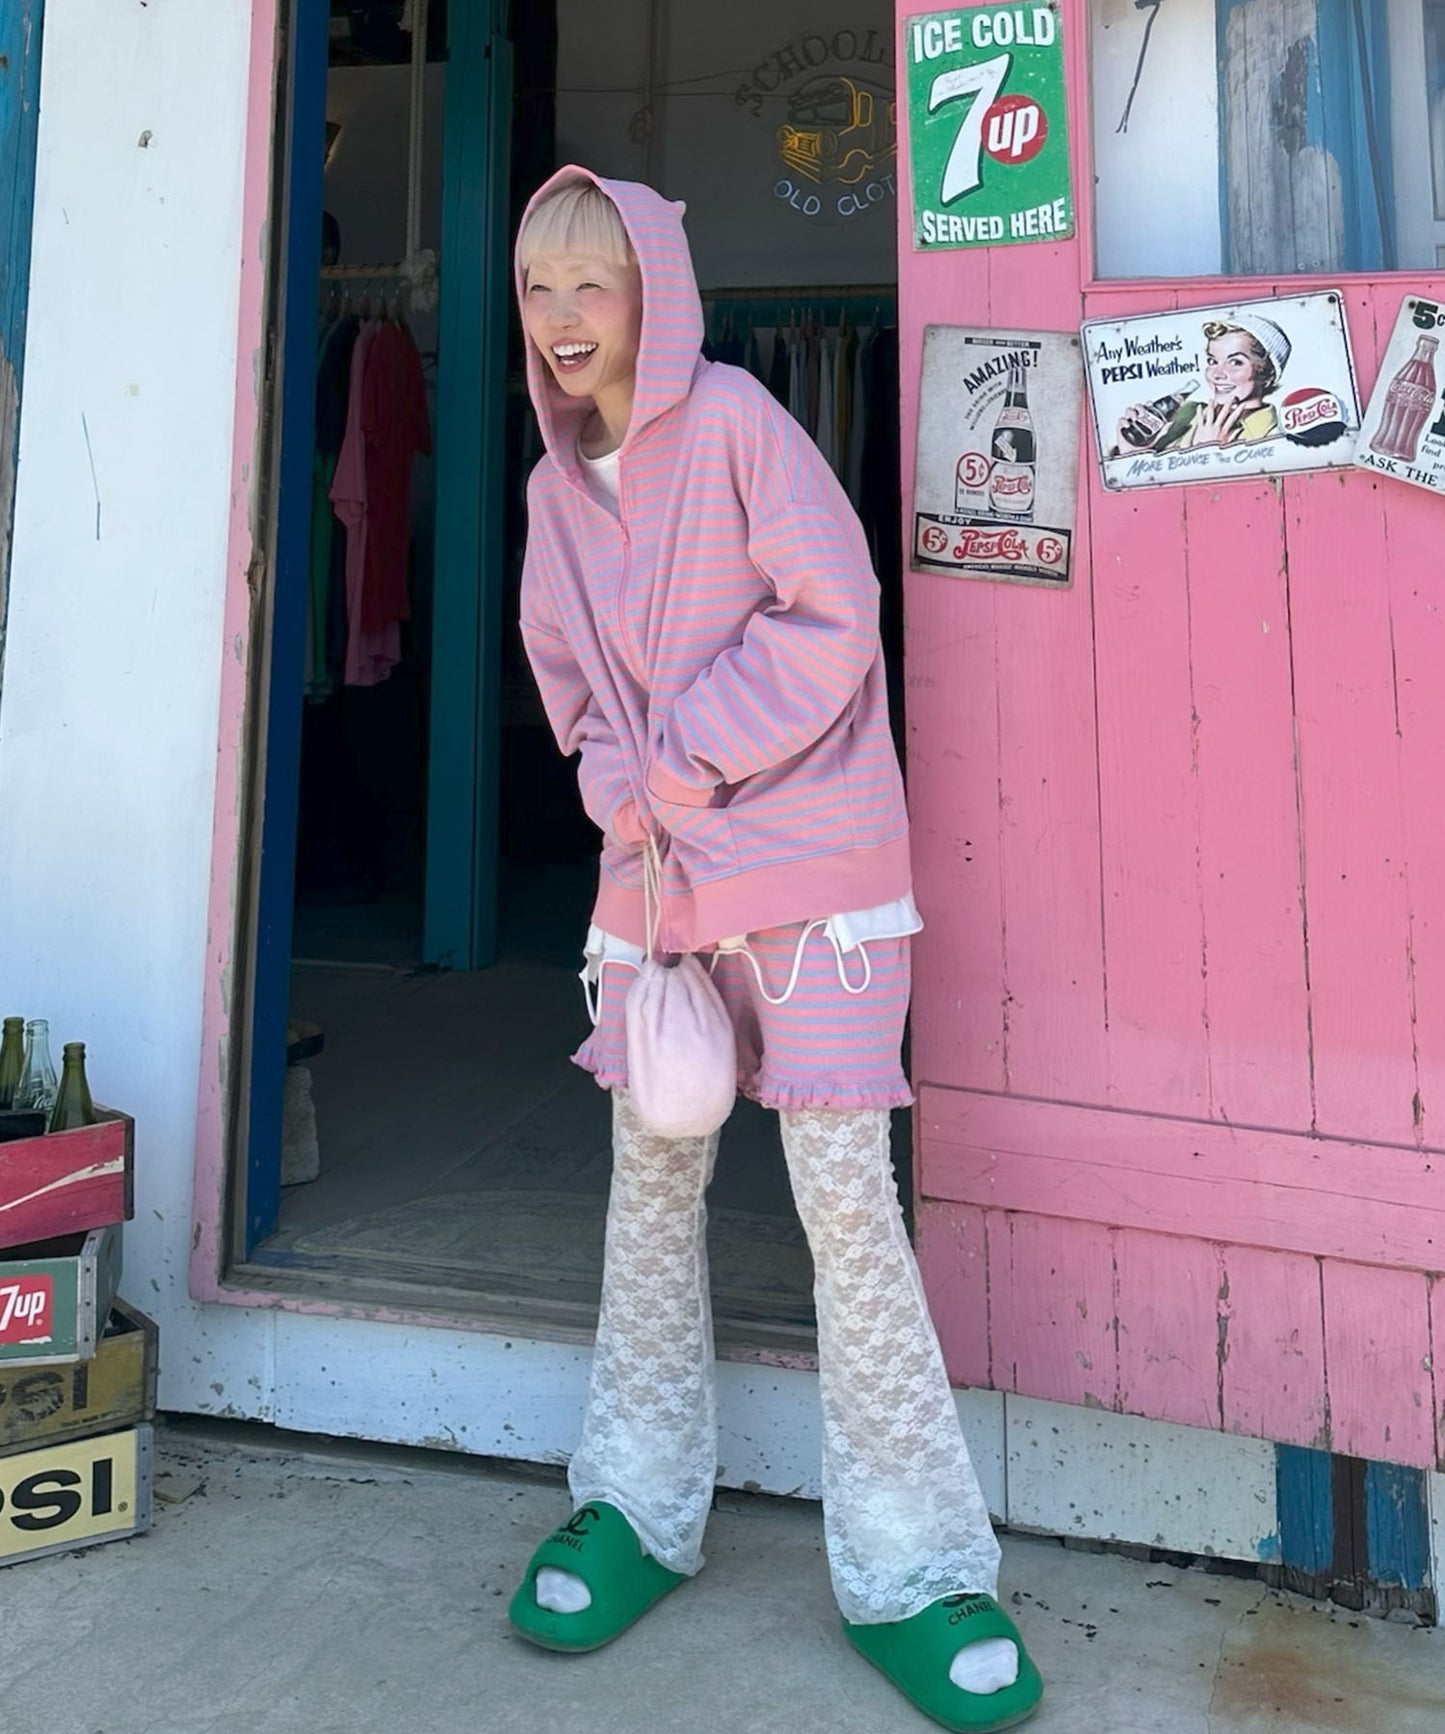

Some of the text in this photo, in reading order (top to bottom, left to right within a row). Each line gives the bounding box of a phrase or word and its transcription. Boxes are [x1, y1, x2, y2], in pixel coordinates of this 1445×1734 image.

[913, 8, 1055, 63] ICE COLD
[774, 179, 821, 215] OLD
[922, 198, 1067, 243] SERVED HERE
[1097, 334, 1183, 364] Any Weather's
[963, 350, 1038, 395] AMAZING!
[1101, 353, 1200, 385] PEPSI Weather!
[1126, 459, 1163, 477] MORE
[1167, 453, 1209, 469] BOUNCE
[1234, 446, 1276, 463] OUNCE
[1364, 454, 1438, 487] ASK THE
[938, 515, 972, 526] ENJOY
[0, 1362, 88, 1421] SI
[0, 1457, 112, 1531] SI
[948, 1601, 994, 1626] CHANEL
